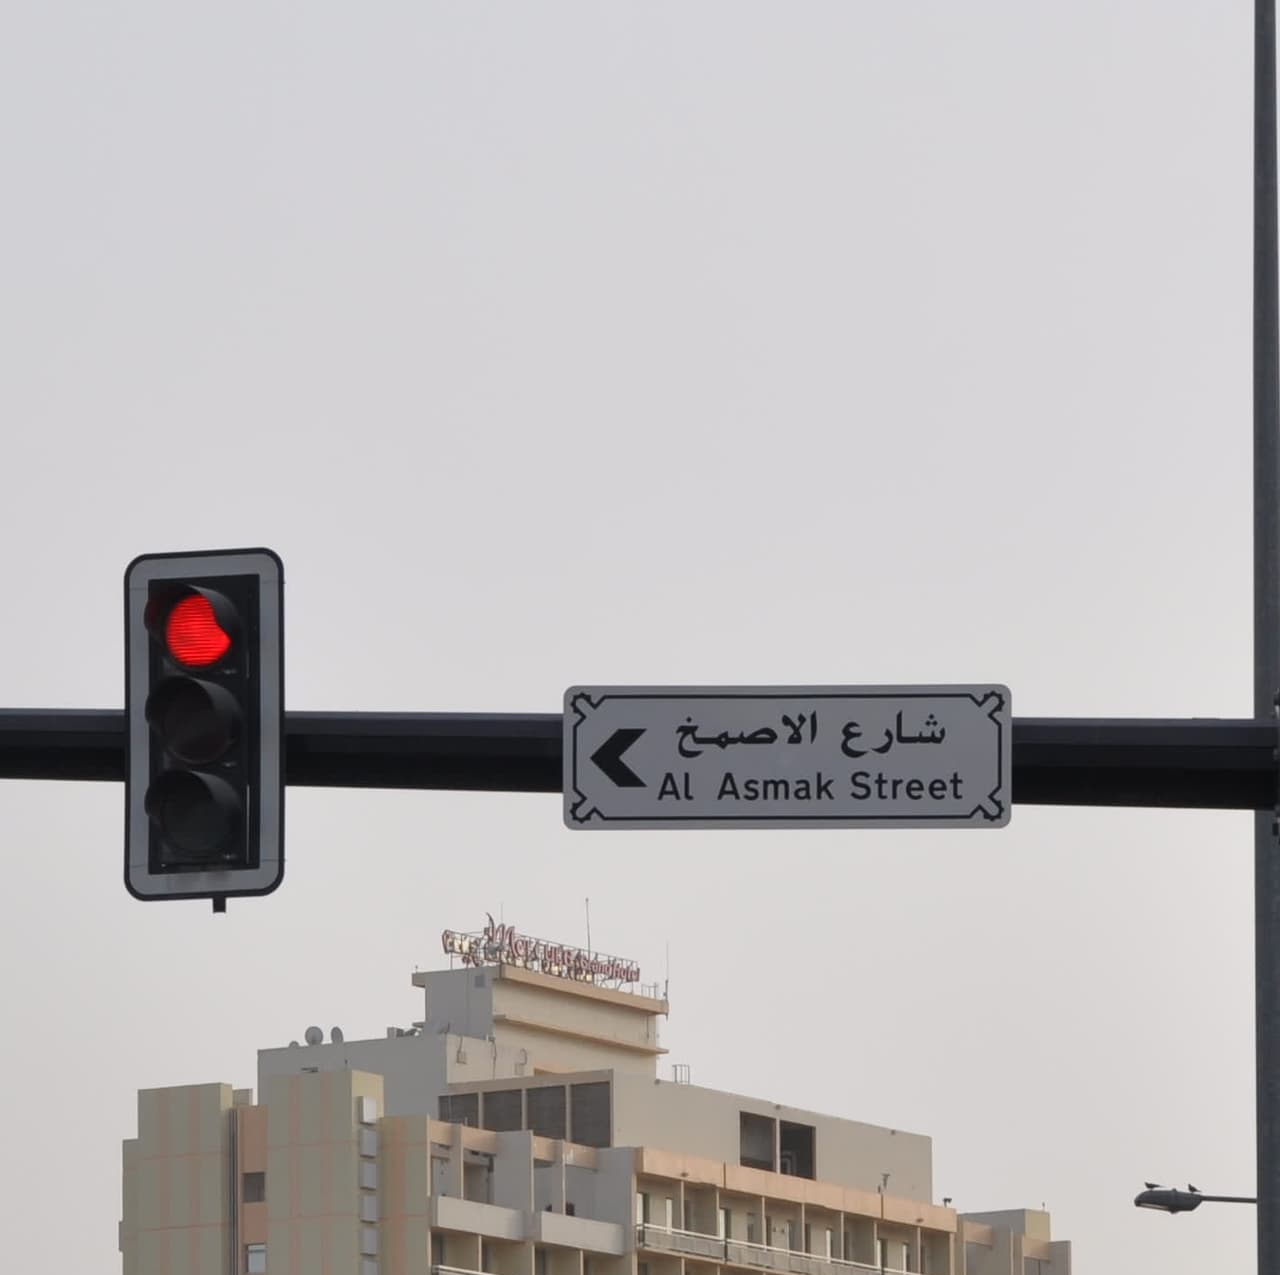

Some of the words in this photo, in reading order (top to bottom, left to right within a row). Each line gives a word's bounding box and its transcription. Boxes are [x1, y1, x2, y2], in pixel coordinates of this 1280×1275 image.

[840, 710, 946, 758] شارع
[657, 771, 695, 801] Al
[717, 771, 835, 801] Asmak
[850, 770, 963, 801] Street
